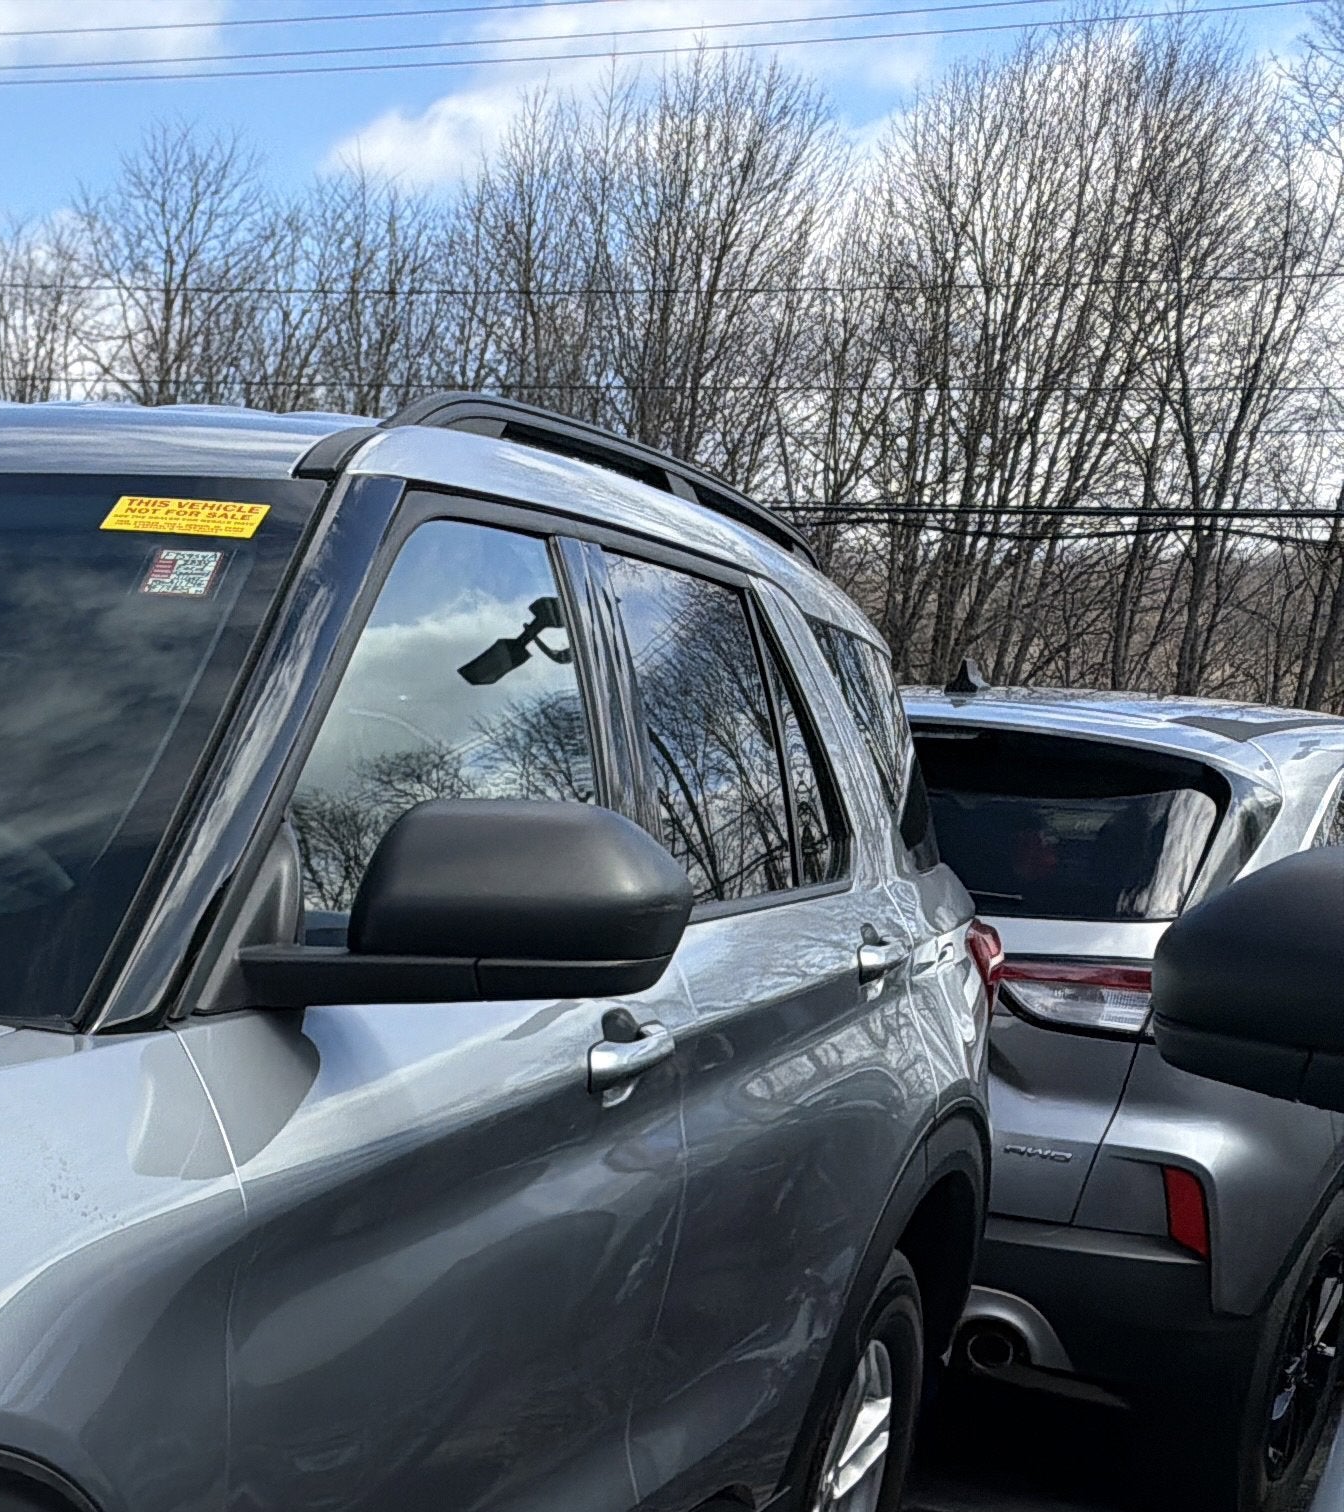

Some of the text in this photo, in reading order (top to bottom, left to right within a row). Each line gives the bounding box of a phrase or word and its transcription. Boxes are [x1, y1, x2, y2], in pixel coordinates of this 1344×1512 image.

[124, 507, 161, 515] NOT
[164, 509, 201, 517] FOR
[206, 511, 253, 521] SALE
[127, 498, 263, 514] THIS VEHICLE
[1004, 1143, 1073, 1163] AWD
